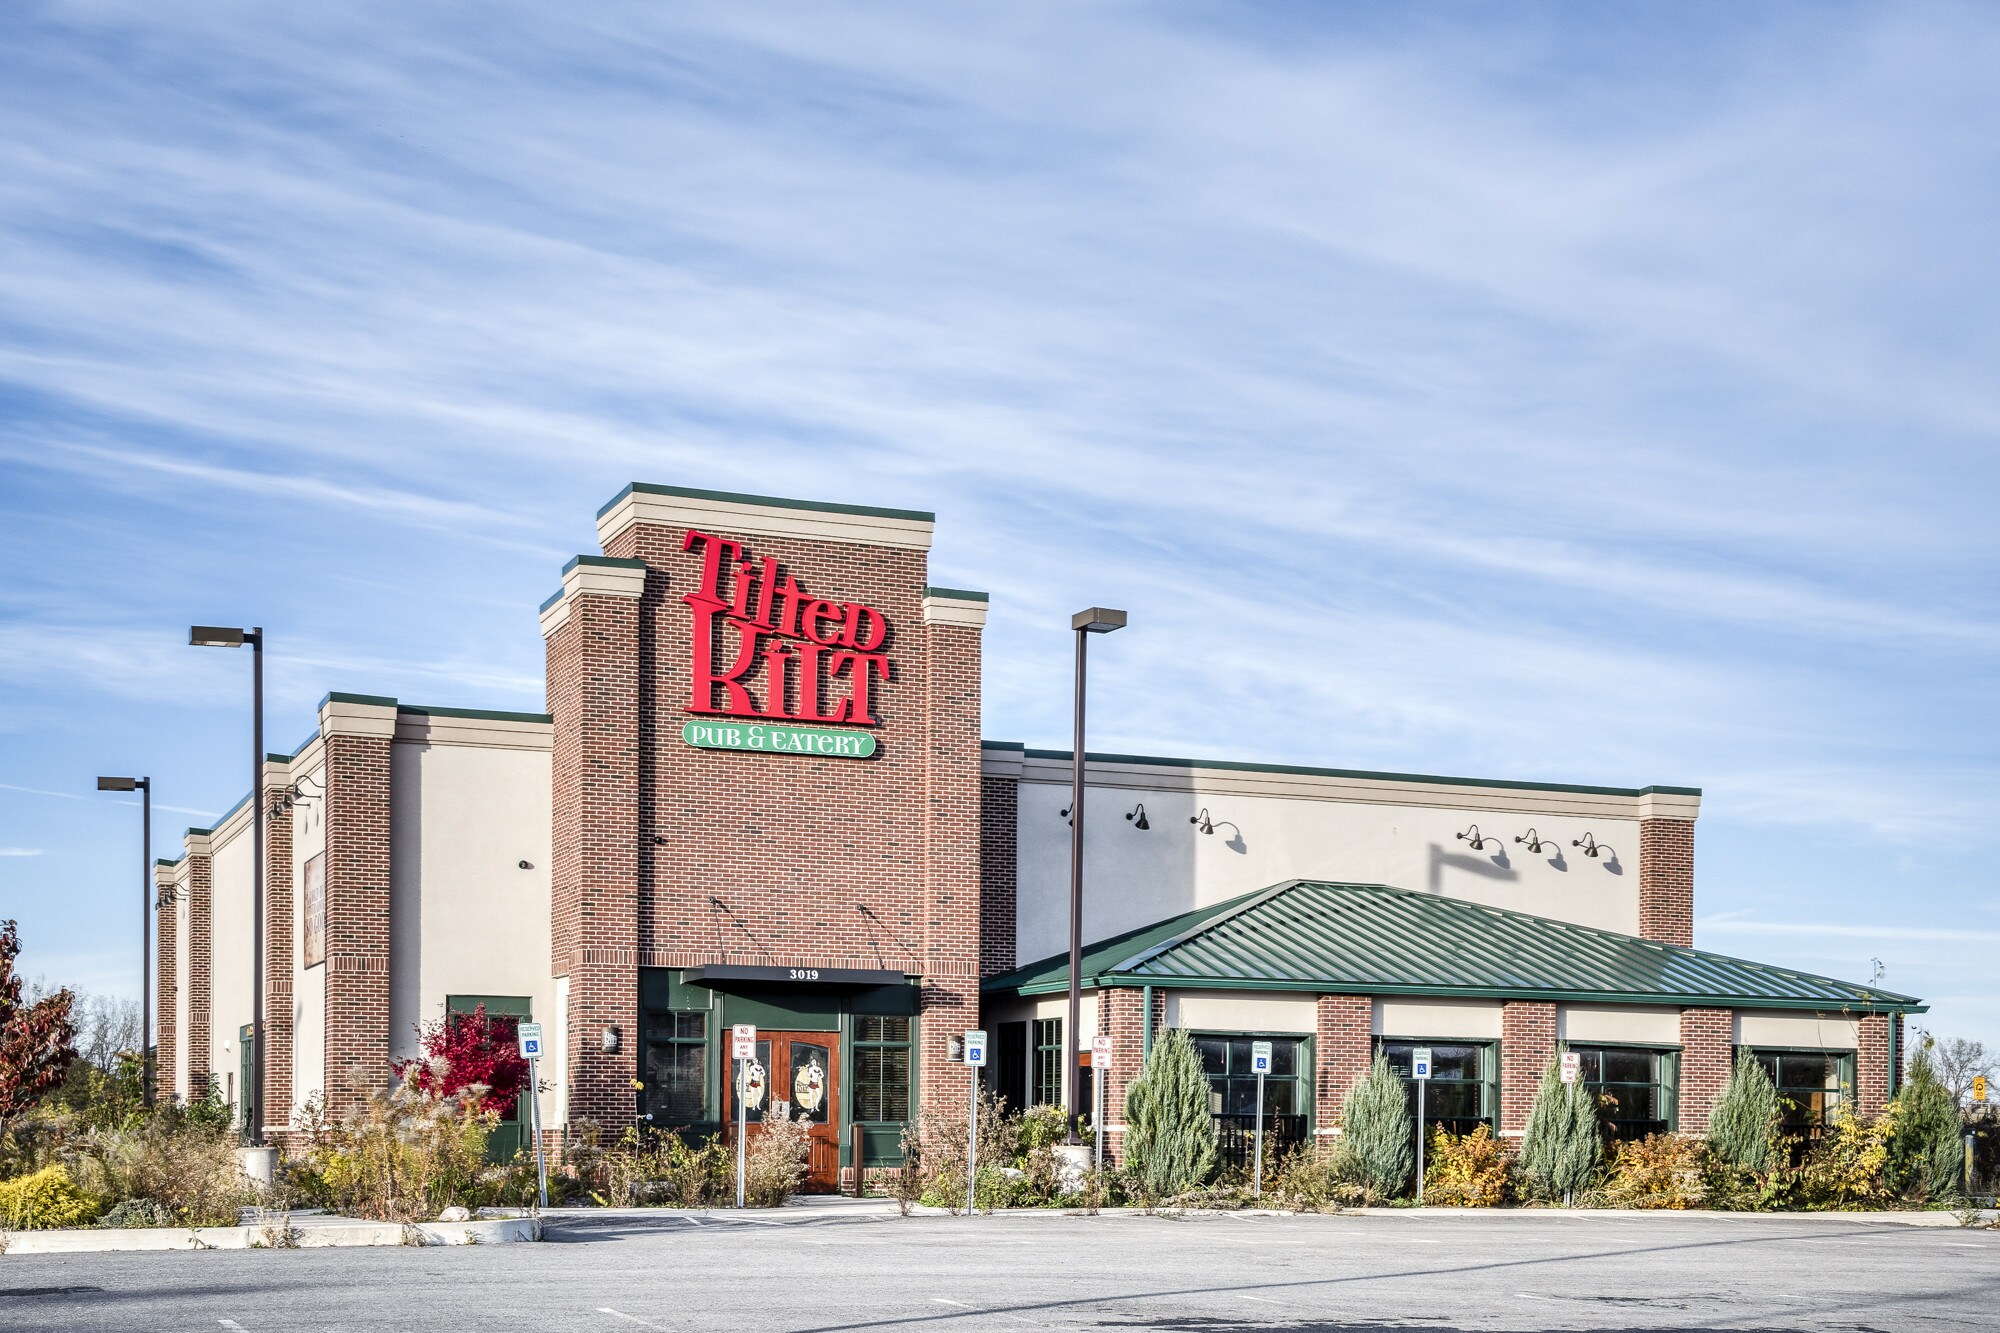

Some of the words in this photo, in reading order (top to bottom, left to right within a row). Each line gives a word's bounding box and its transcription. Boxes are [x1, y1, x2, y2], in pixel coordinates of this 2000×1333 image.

[691, 725, 742, 747] PUB
[747, 726, 766, 748] &
[789, 968, 819, 980] 3019
[740, 1027, 749, 1035] NO
